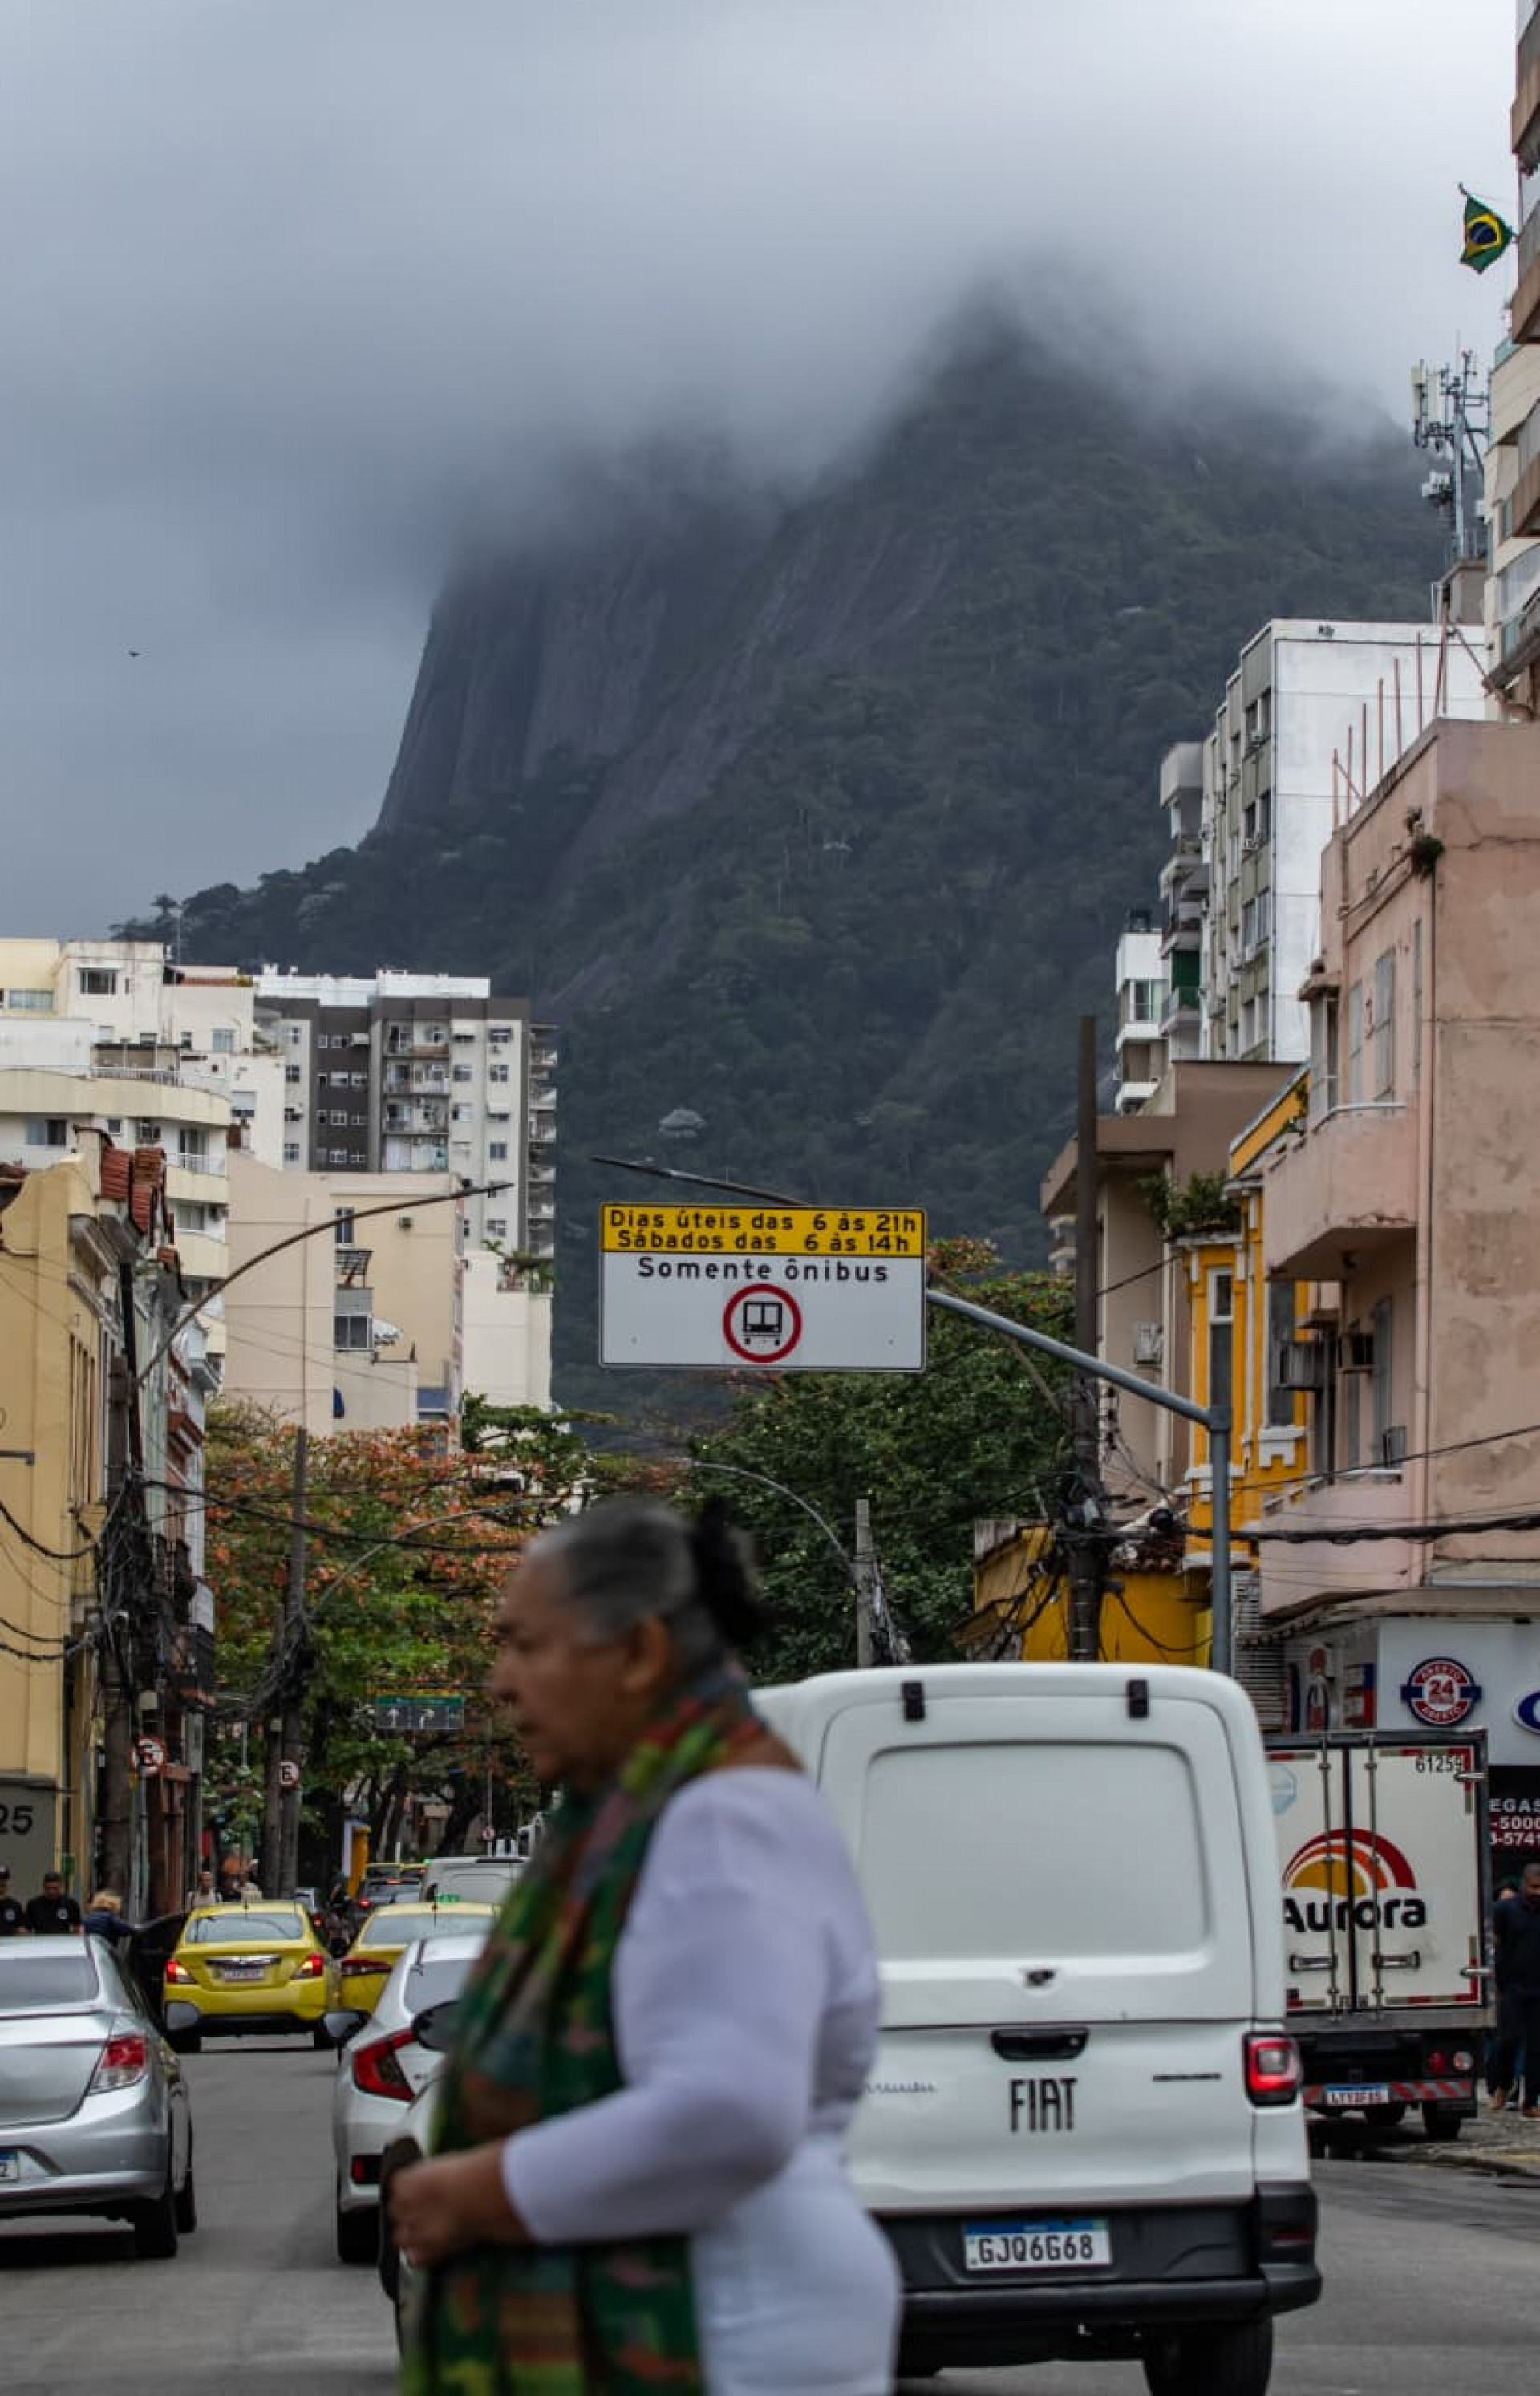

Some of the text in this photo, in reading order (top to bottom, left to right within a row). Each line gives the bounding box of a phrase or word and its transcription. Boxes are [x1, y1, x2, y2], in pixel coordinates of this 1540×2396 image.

[611, 1209, 664, 1229] Dias
[677, 1209, 740, 1229] úteis
[752, 1212, 793, 1230] das
[813, 1212, 827, 1230] 6
[876, 1214, 916, 1233] 21h
[617, 1229, 723, 1249] Sábados
[735, 1231, 776, 1250] das
[804, 1233, 819, 1251] 6
[868, 1233, 909, 1251] 14h
[638, 1255, 888, 1281] Somente ônibus
[1428, 1680, 1455, 1695] 24
[1283, 1897, 1428, 1932] Aurora
[1009, 2078, 1078, 2132] FIAT
[978, 2233, 1094, 2264] GJQ6G68
